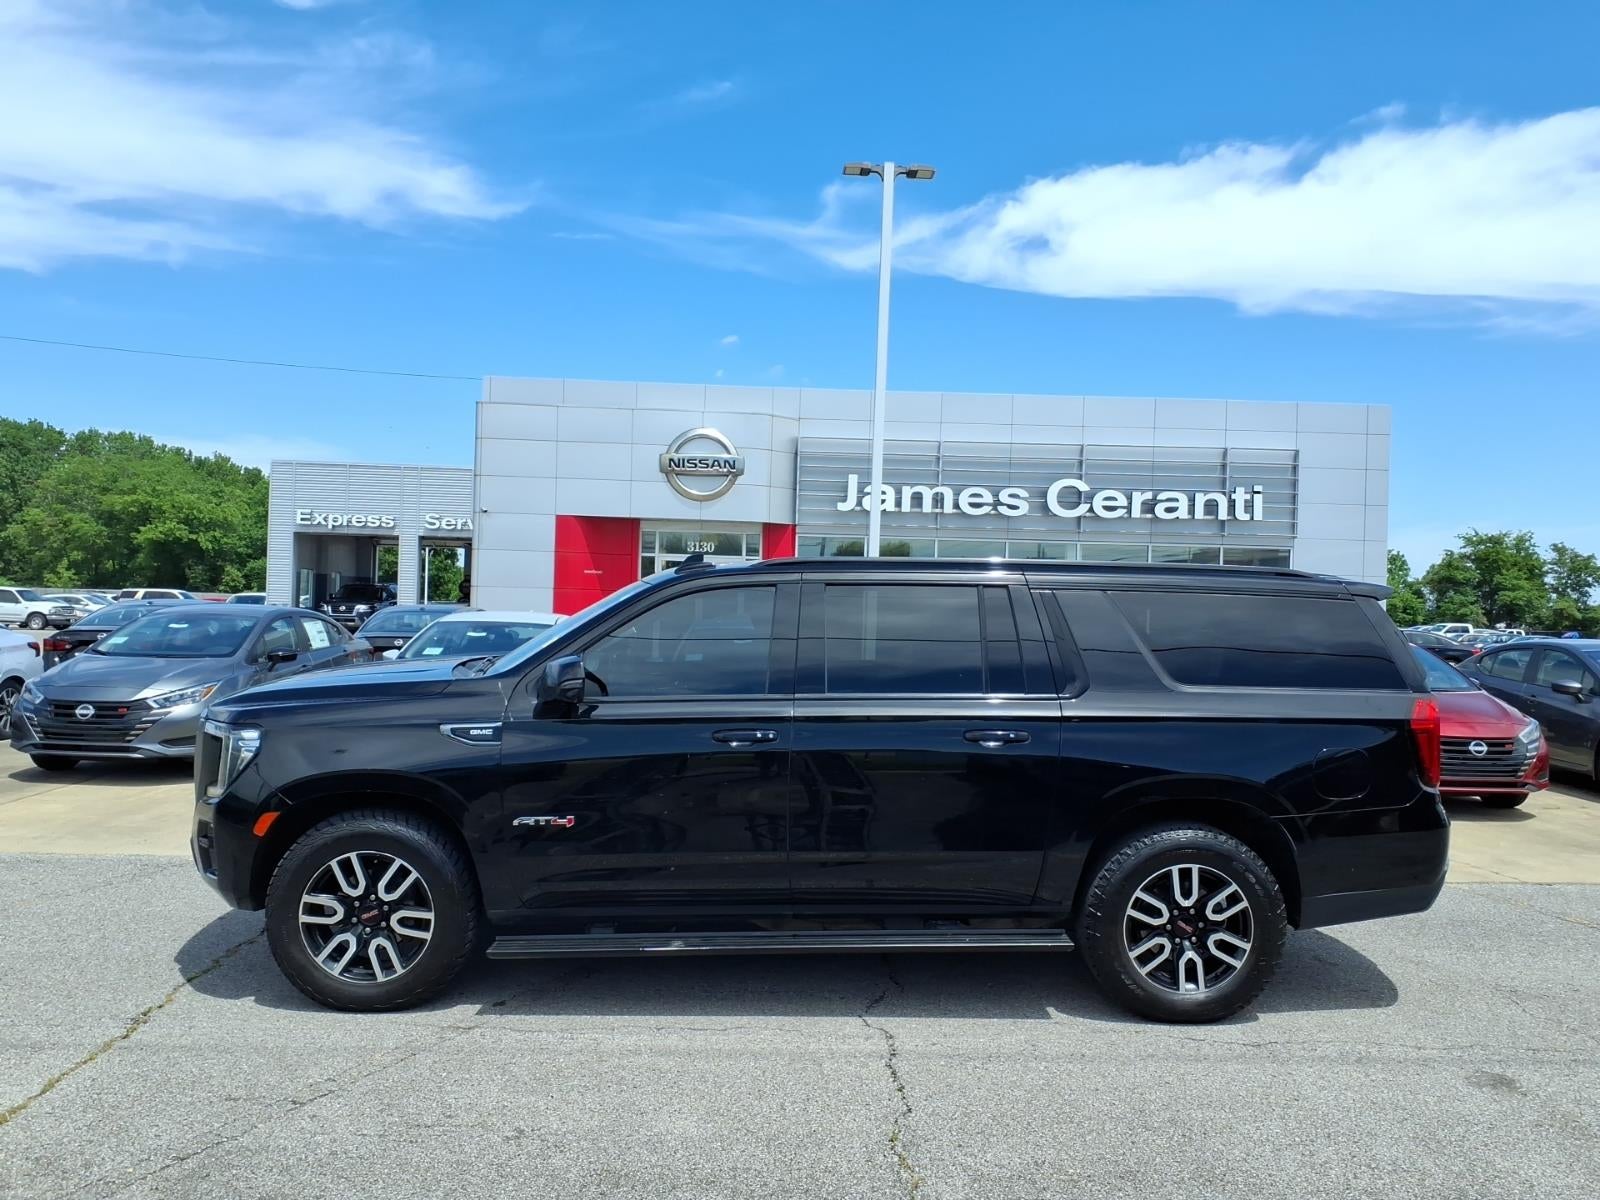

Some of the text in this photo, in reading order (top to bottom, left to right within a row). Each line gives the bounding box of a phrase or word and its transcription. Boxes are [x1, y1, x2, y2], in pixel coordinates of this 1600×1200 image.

[668, 458, 736, 470] NISSAN
[837, 474, 1263, 521] James Ceranti
[295, 509, 395, 529] Express
[687, 541, 715, 553] 3130
